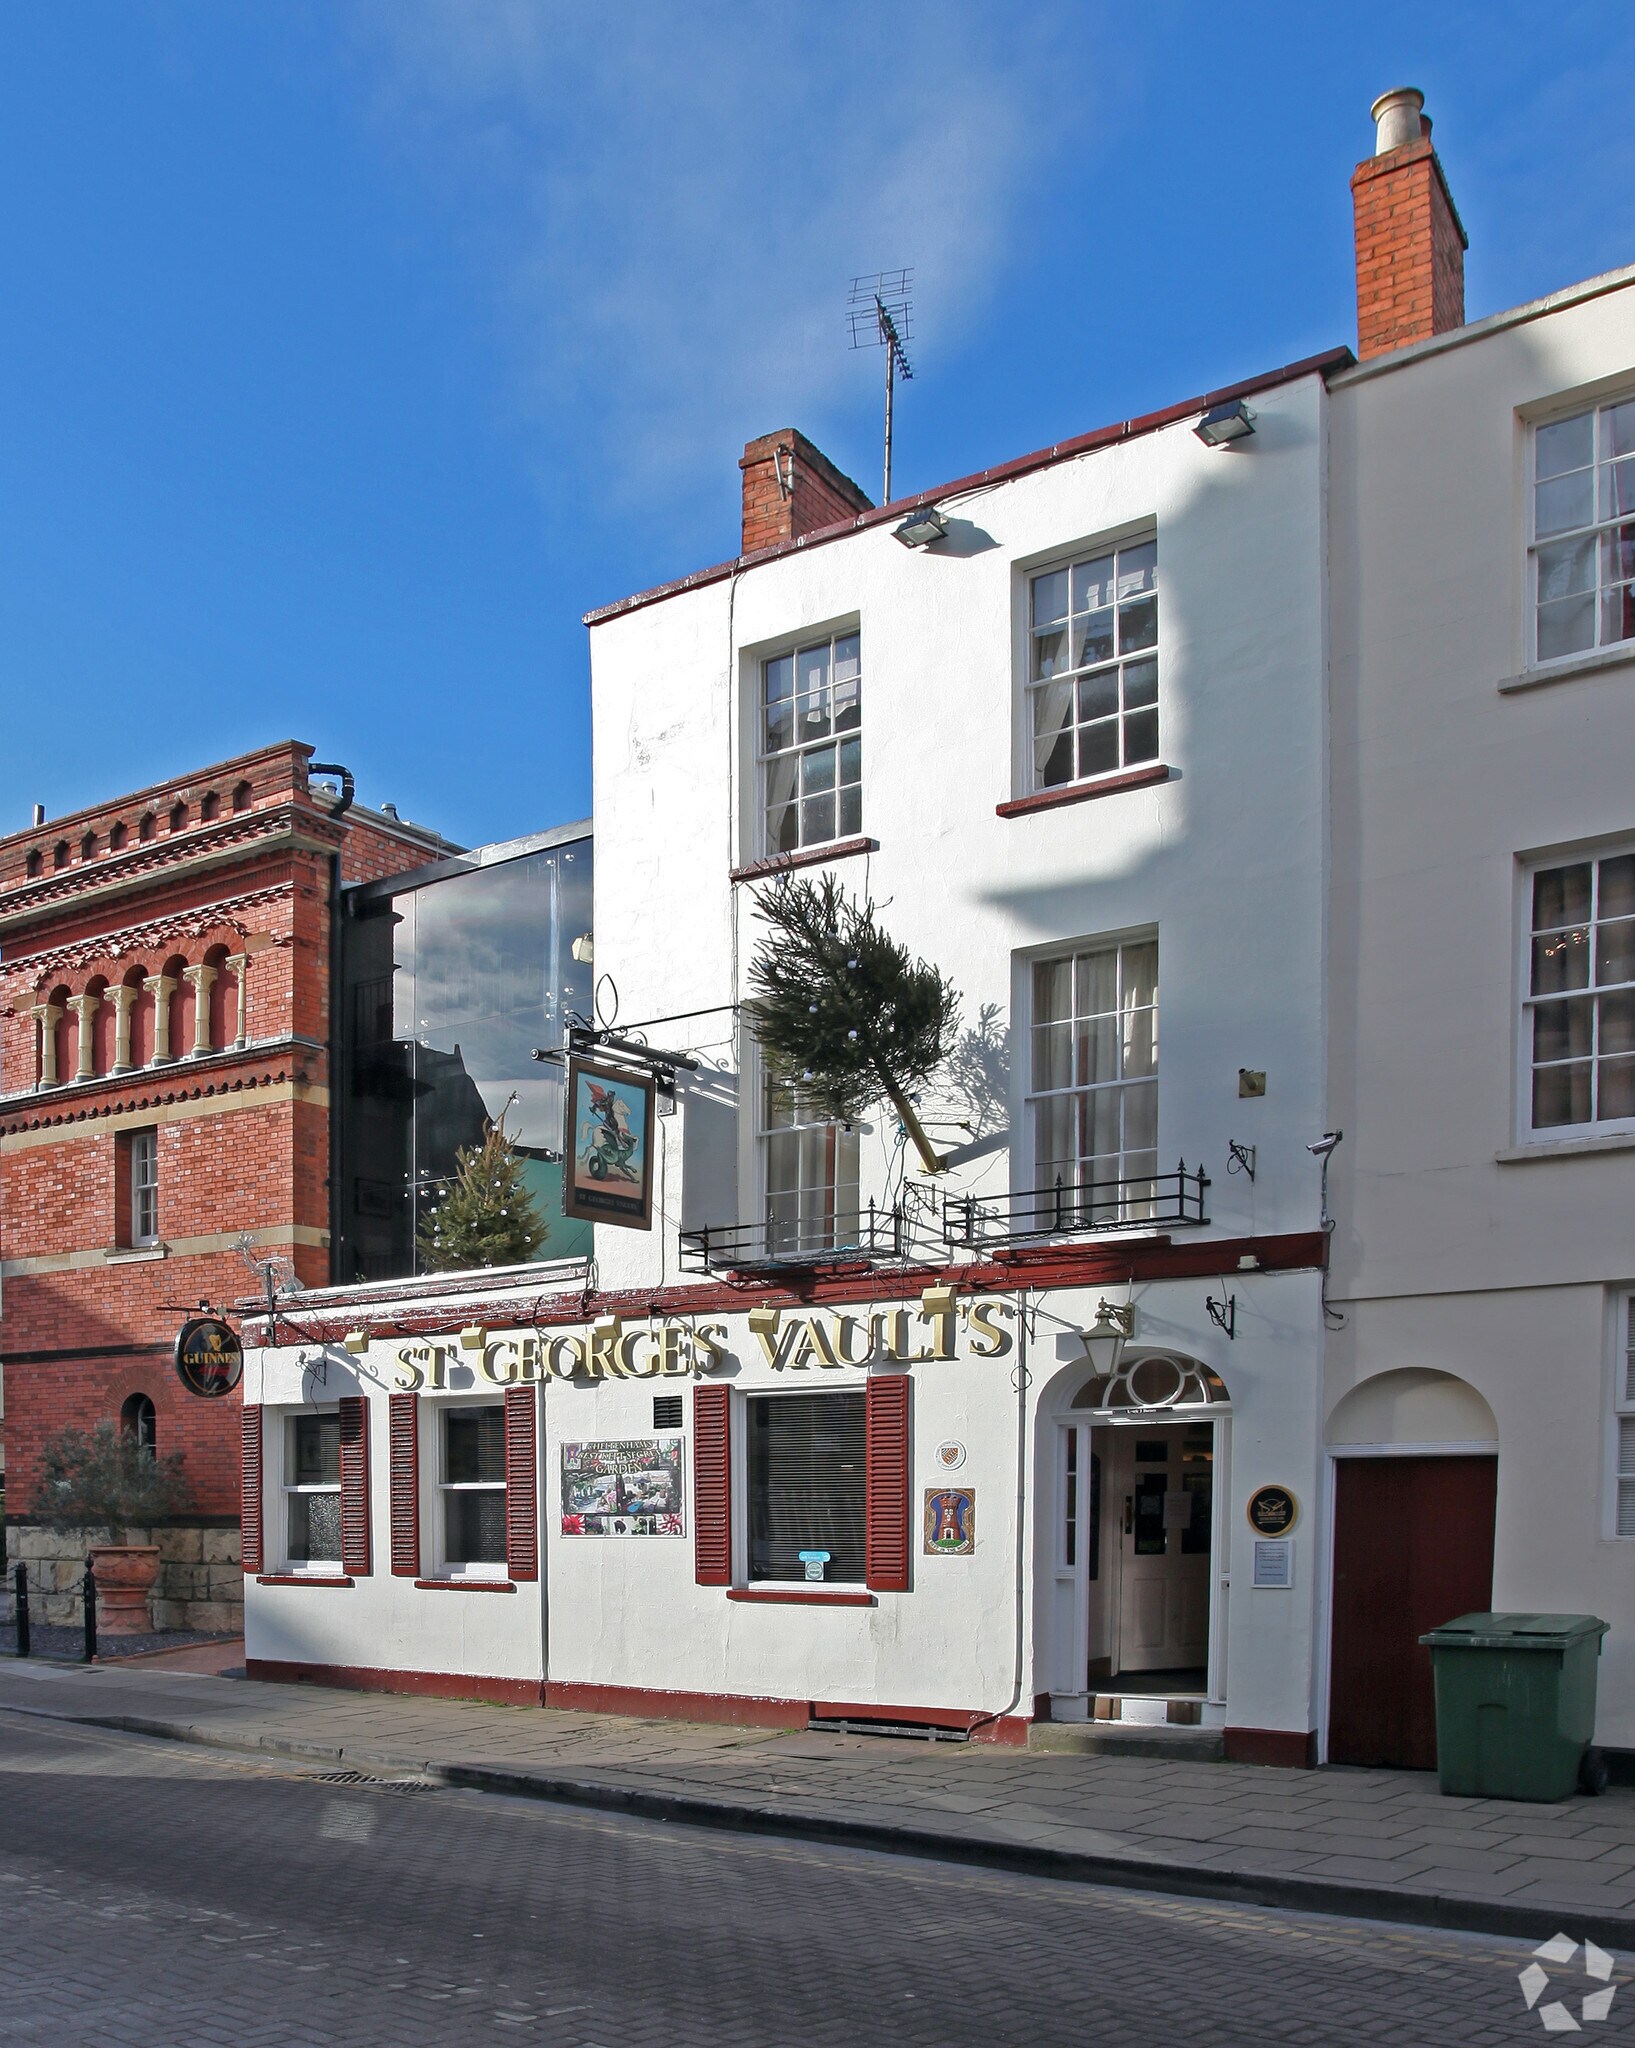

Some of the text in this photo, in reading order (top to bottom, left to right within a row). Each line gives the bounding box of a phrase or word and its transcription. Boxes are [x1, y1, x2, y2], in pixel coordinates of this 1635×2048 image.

[393, 1302, 1008, 1391] ST GEORGES VAULTS
[183, 1351, 240, 1364] GUINNESS
[595, 1462, 642, 1475] GARDEN
